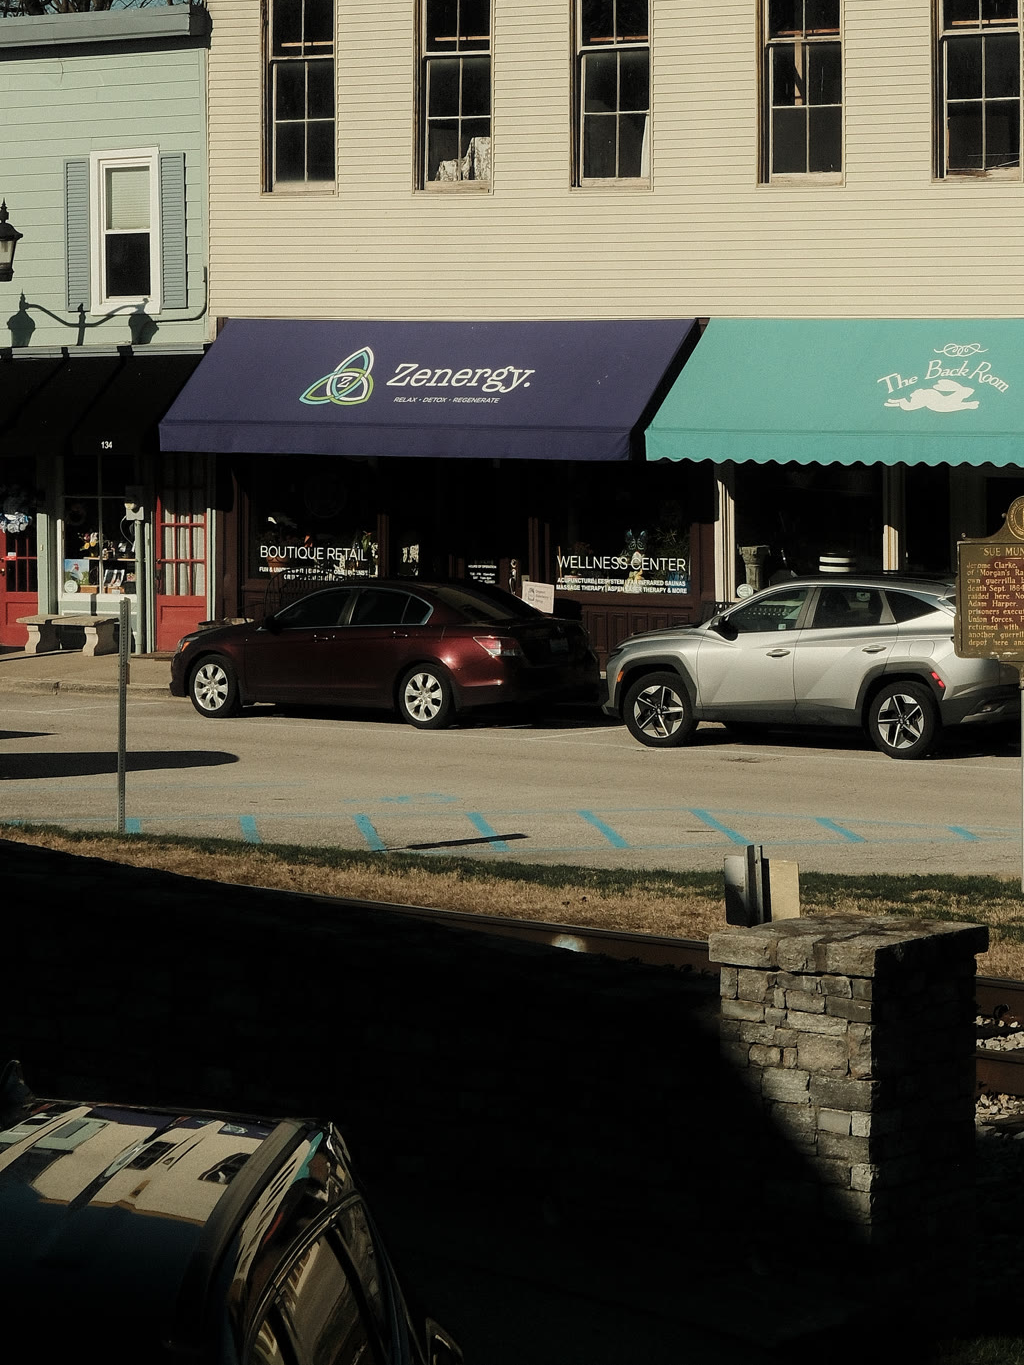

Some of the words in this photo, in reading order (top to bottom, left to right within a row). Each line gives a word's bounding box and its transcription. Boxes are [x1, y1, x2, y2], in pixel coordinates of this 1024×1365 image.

[386, 363, 536, 393] Zenergy.
[876, 372, 918, 394] The
[924, 359, 970, 380] Back
[968, 361, 1009, 393] Room
[100, 440, 112, 449] 134
[260, 546, 324, 560] BOUTIQUE
[327, 548, 368, 562] RETAIL
[556, 556, 628, 570] WELLNESS
[630, 557, 686, 572] CENTER
[986, 577, 1015, 585] guerrilla
[990, 585, 1006, 593] Sept.
